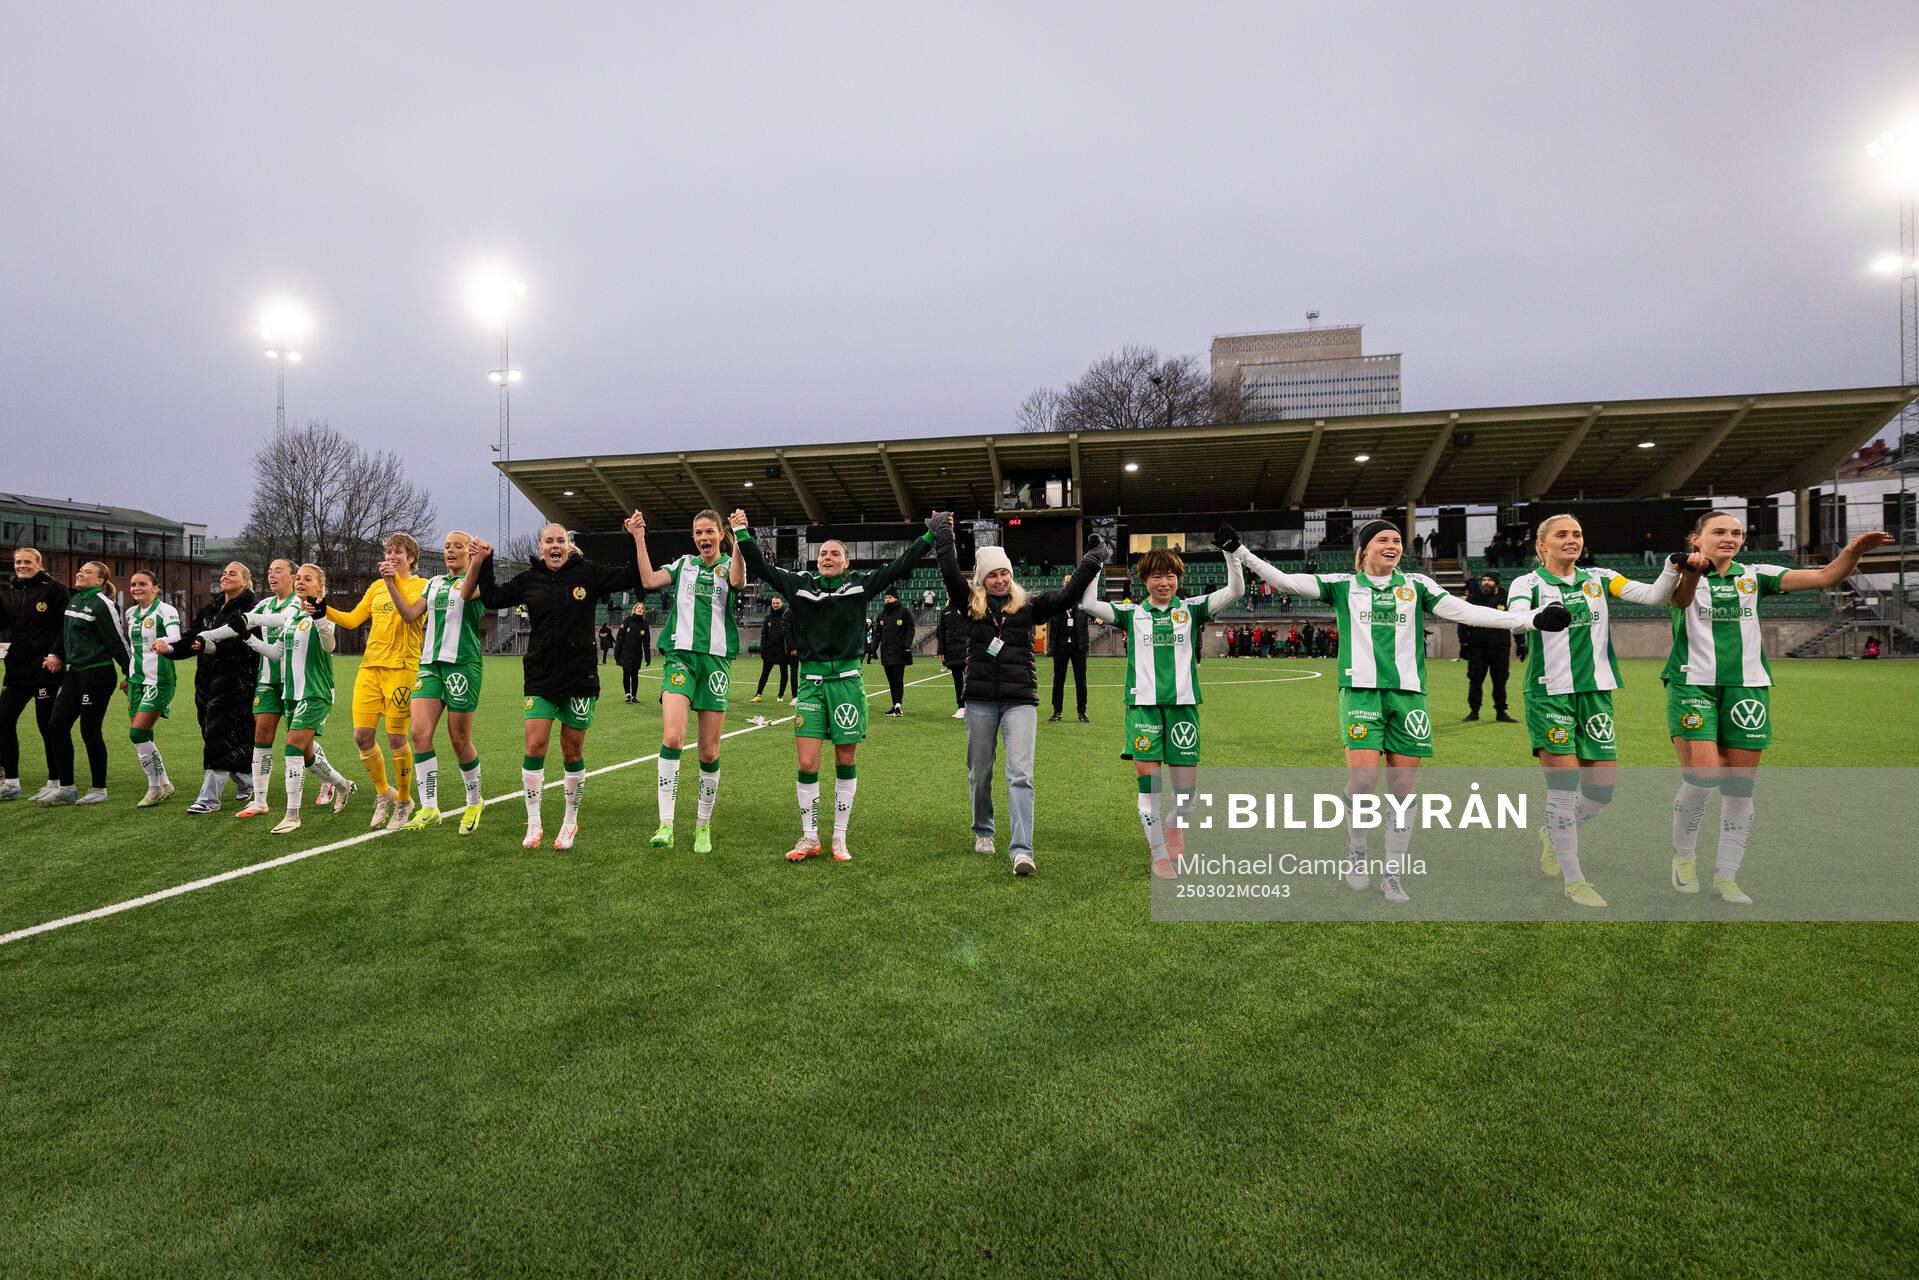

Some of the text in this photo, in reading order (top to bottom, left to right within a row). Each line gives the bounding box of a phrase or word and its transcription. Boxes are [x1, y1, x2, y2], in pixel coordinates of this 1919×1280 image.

[1360, 611, 1407, 623] PROJOB
[1698, 606, 1753, 617] PROJOB
[1143, 633, 1184, 643] PROJOB
[426, 770, 438, 799] Clinton.
